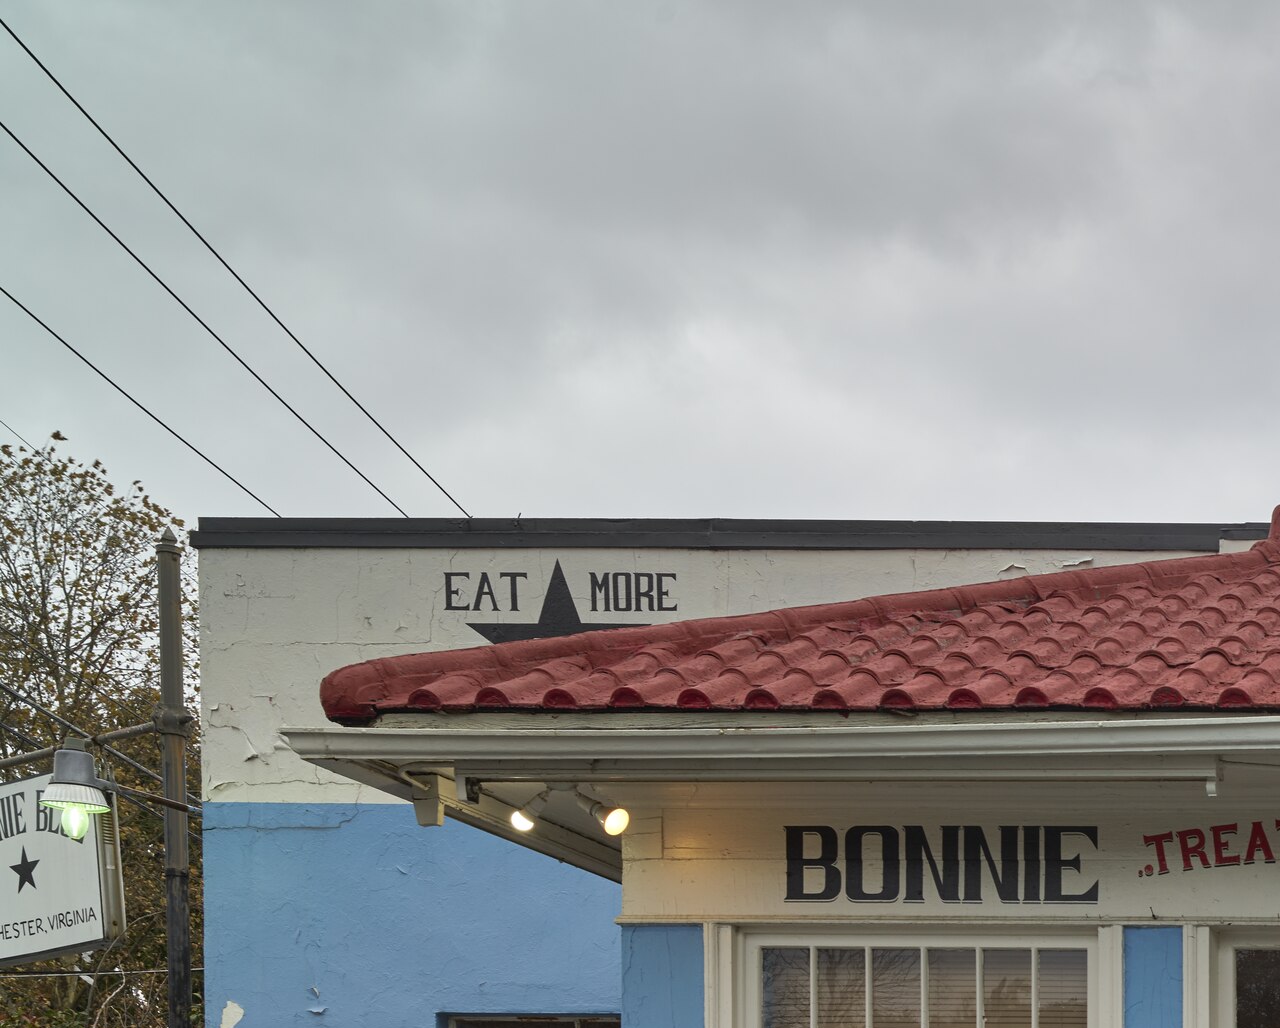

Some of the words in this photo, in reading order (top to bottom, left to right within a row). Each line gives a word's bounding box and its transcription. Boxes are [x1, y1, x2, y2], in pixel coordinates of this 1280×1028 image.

[443, 571, 529, 613] EAT
[589, 571, 679, 613] MORE
[783, 824, 1100, 905] BONNIE
[47, 907, 97, 933] VIRGINIA
